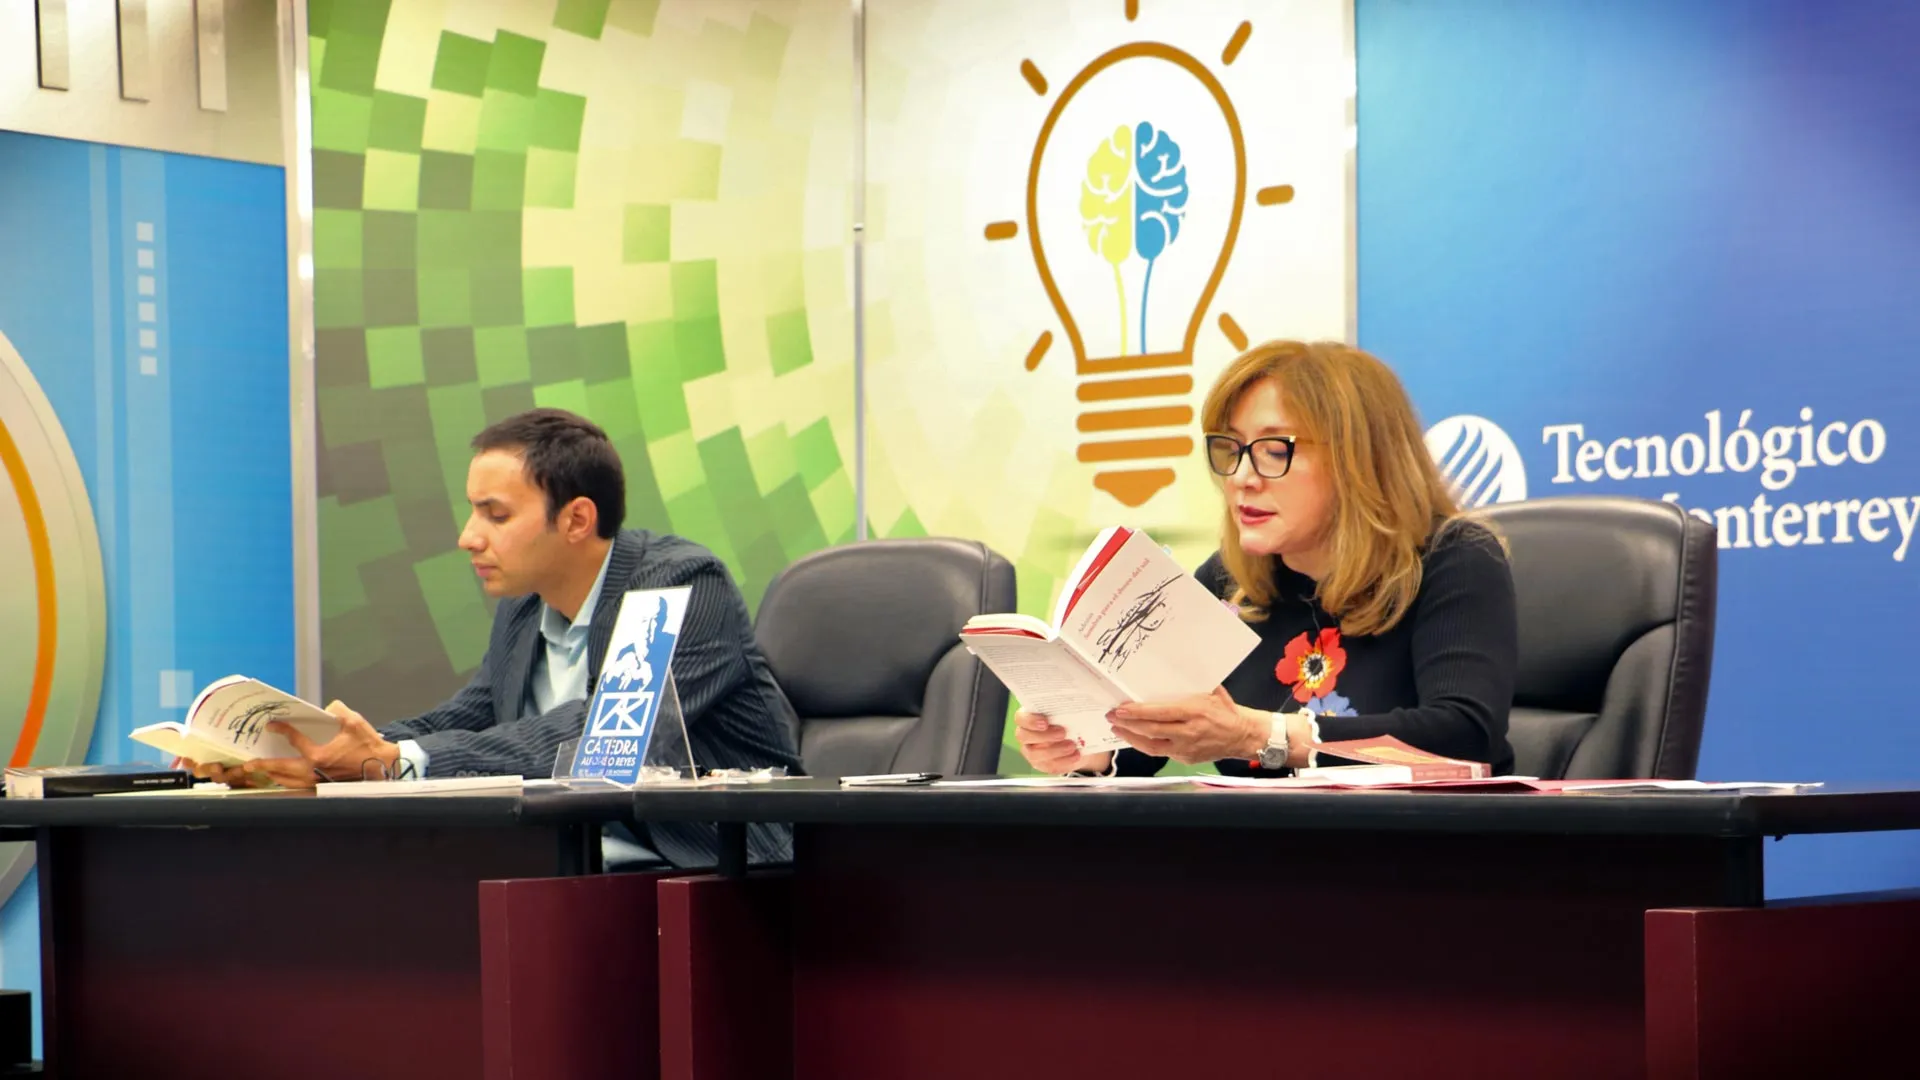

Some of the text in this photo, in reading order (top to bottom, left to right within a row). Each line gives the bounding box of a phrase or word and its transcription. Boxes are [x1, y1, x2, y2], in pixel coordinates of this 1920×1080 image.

[1543, 407, 1886, 490] Tecnológico
[1662, 492, 1920, 562] nterrey
[615, 757, 637, 767] REYES
